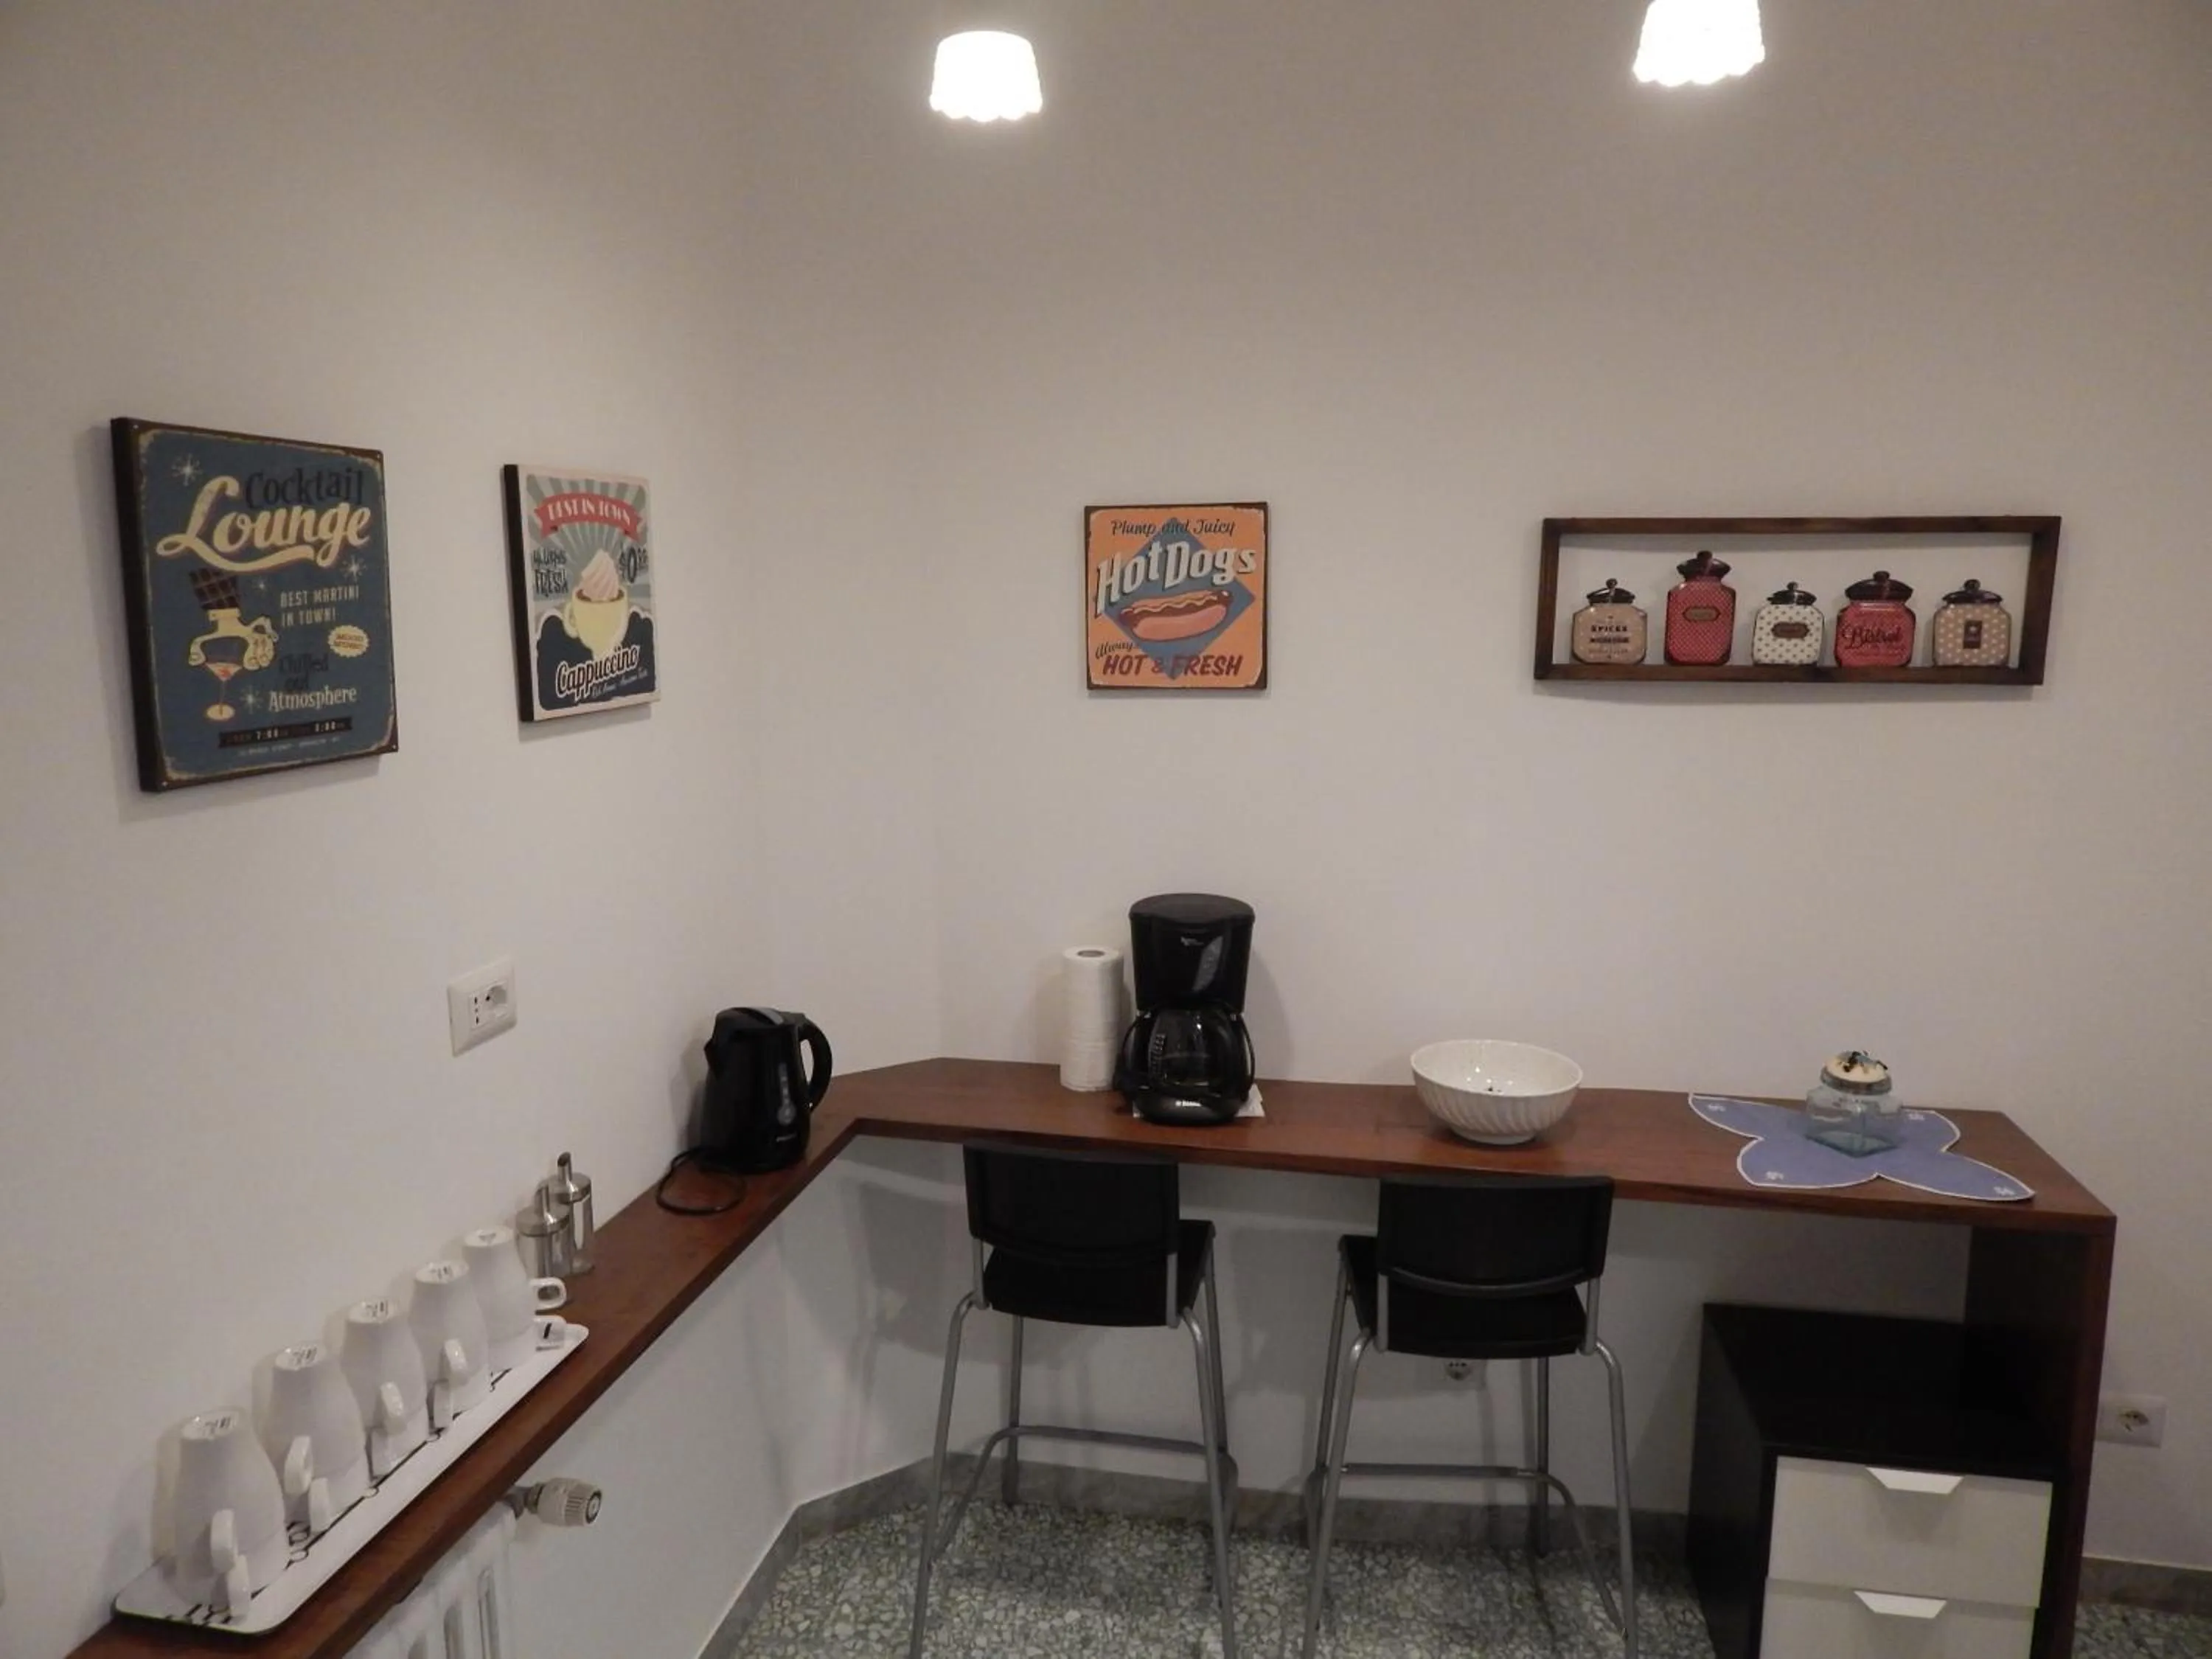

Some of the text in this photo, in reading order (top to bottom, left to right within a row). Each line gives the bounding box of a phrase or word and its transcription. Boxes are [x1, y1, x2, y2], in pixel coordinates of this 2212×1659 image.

[245, 467, 364, 509] Cocktail
[156, 475, 371, 571] Lounge
[1111, 519, 1156, 536] Plump
[1194, 519, 1237, 536] Juicy
[280, 585, 359, 608] BEST MARTINI
[282, 612, 294, 627] IN
[555, 644, 640, 703] Cappuccino
[1102, 654, 1147, 675] HOT
[1171, 654, 1243, 676] FRESH
[268, 684, 358, 713] Atmosphere
